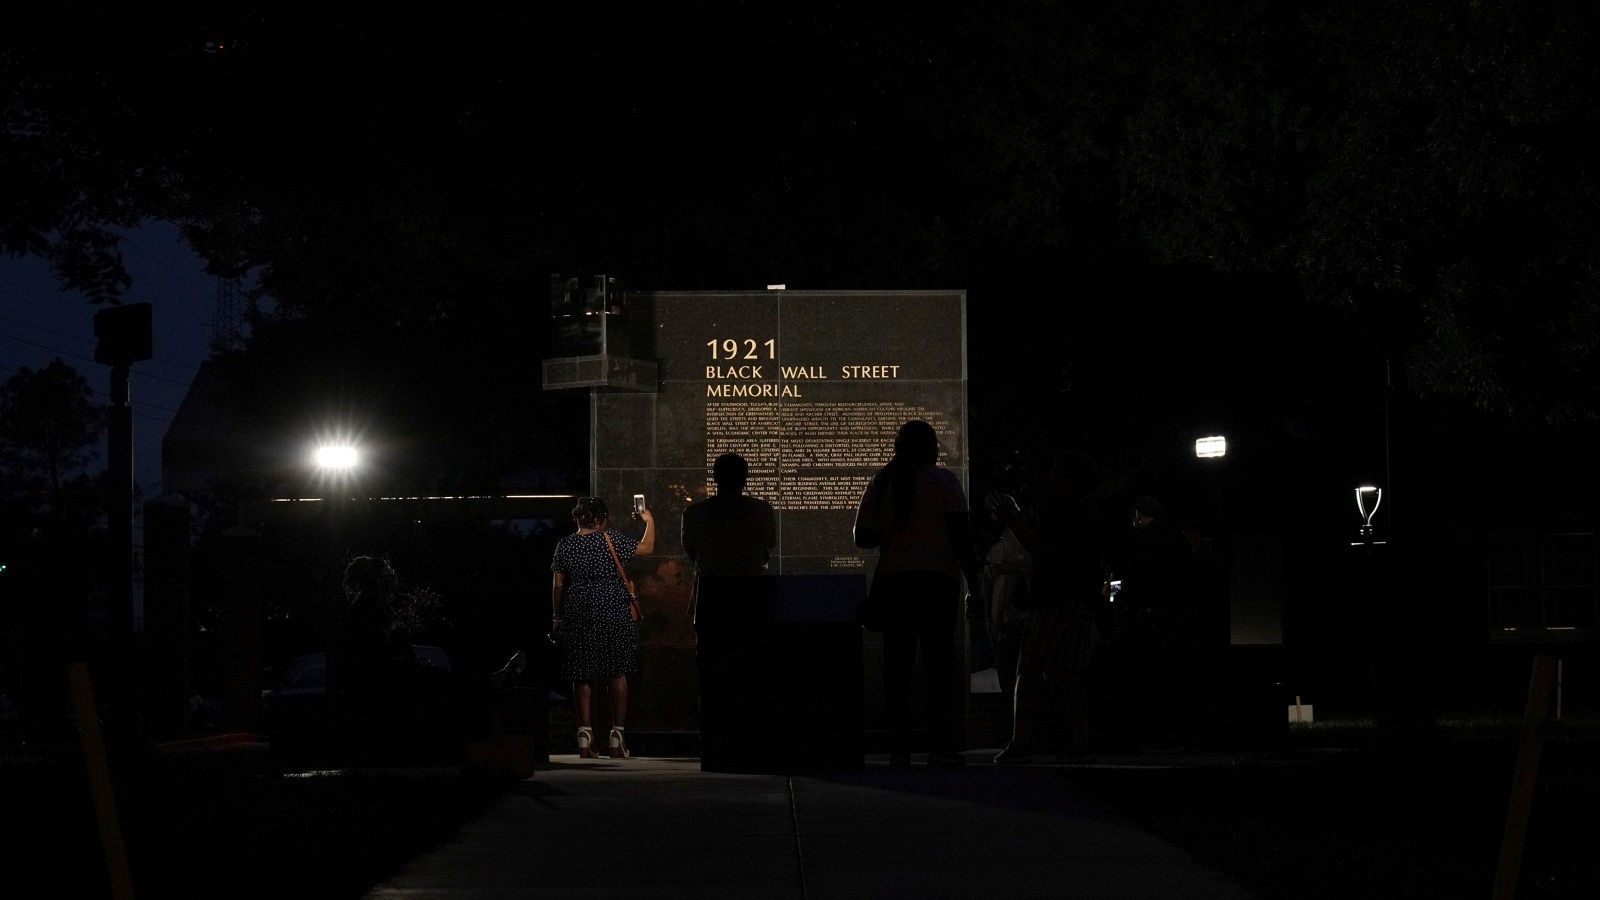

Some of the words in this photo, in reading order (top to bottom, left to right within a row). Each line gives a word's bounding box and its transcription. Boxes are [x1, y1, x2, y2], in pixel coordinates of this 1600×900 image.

[706, 339, 775, 360] 1921
[706, 366, 762, 379] BLACK
[780, 366, 827, 379] WALL
[842, 366, 900, 379] STREET
[706, 384, 802, 397] MEMORIAL
